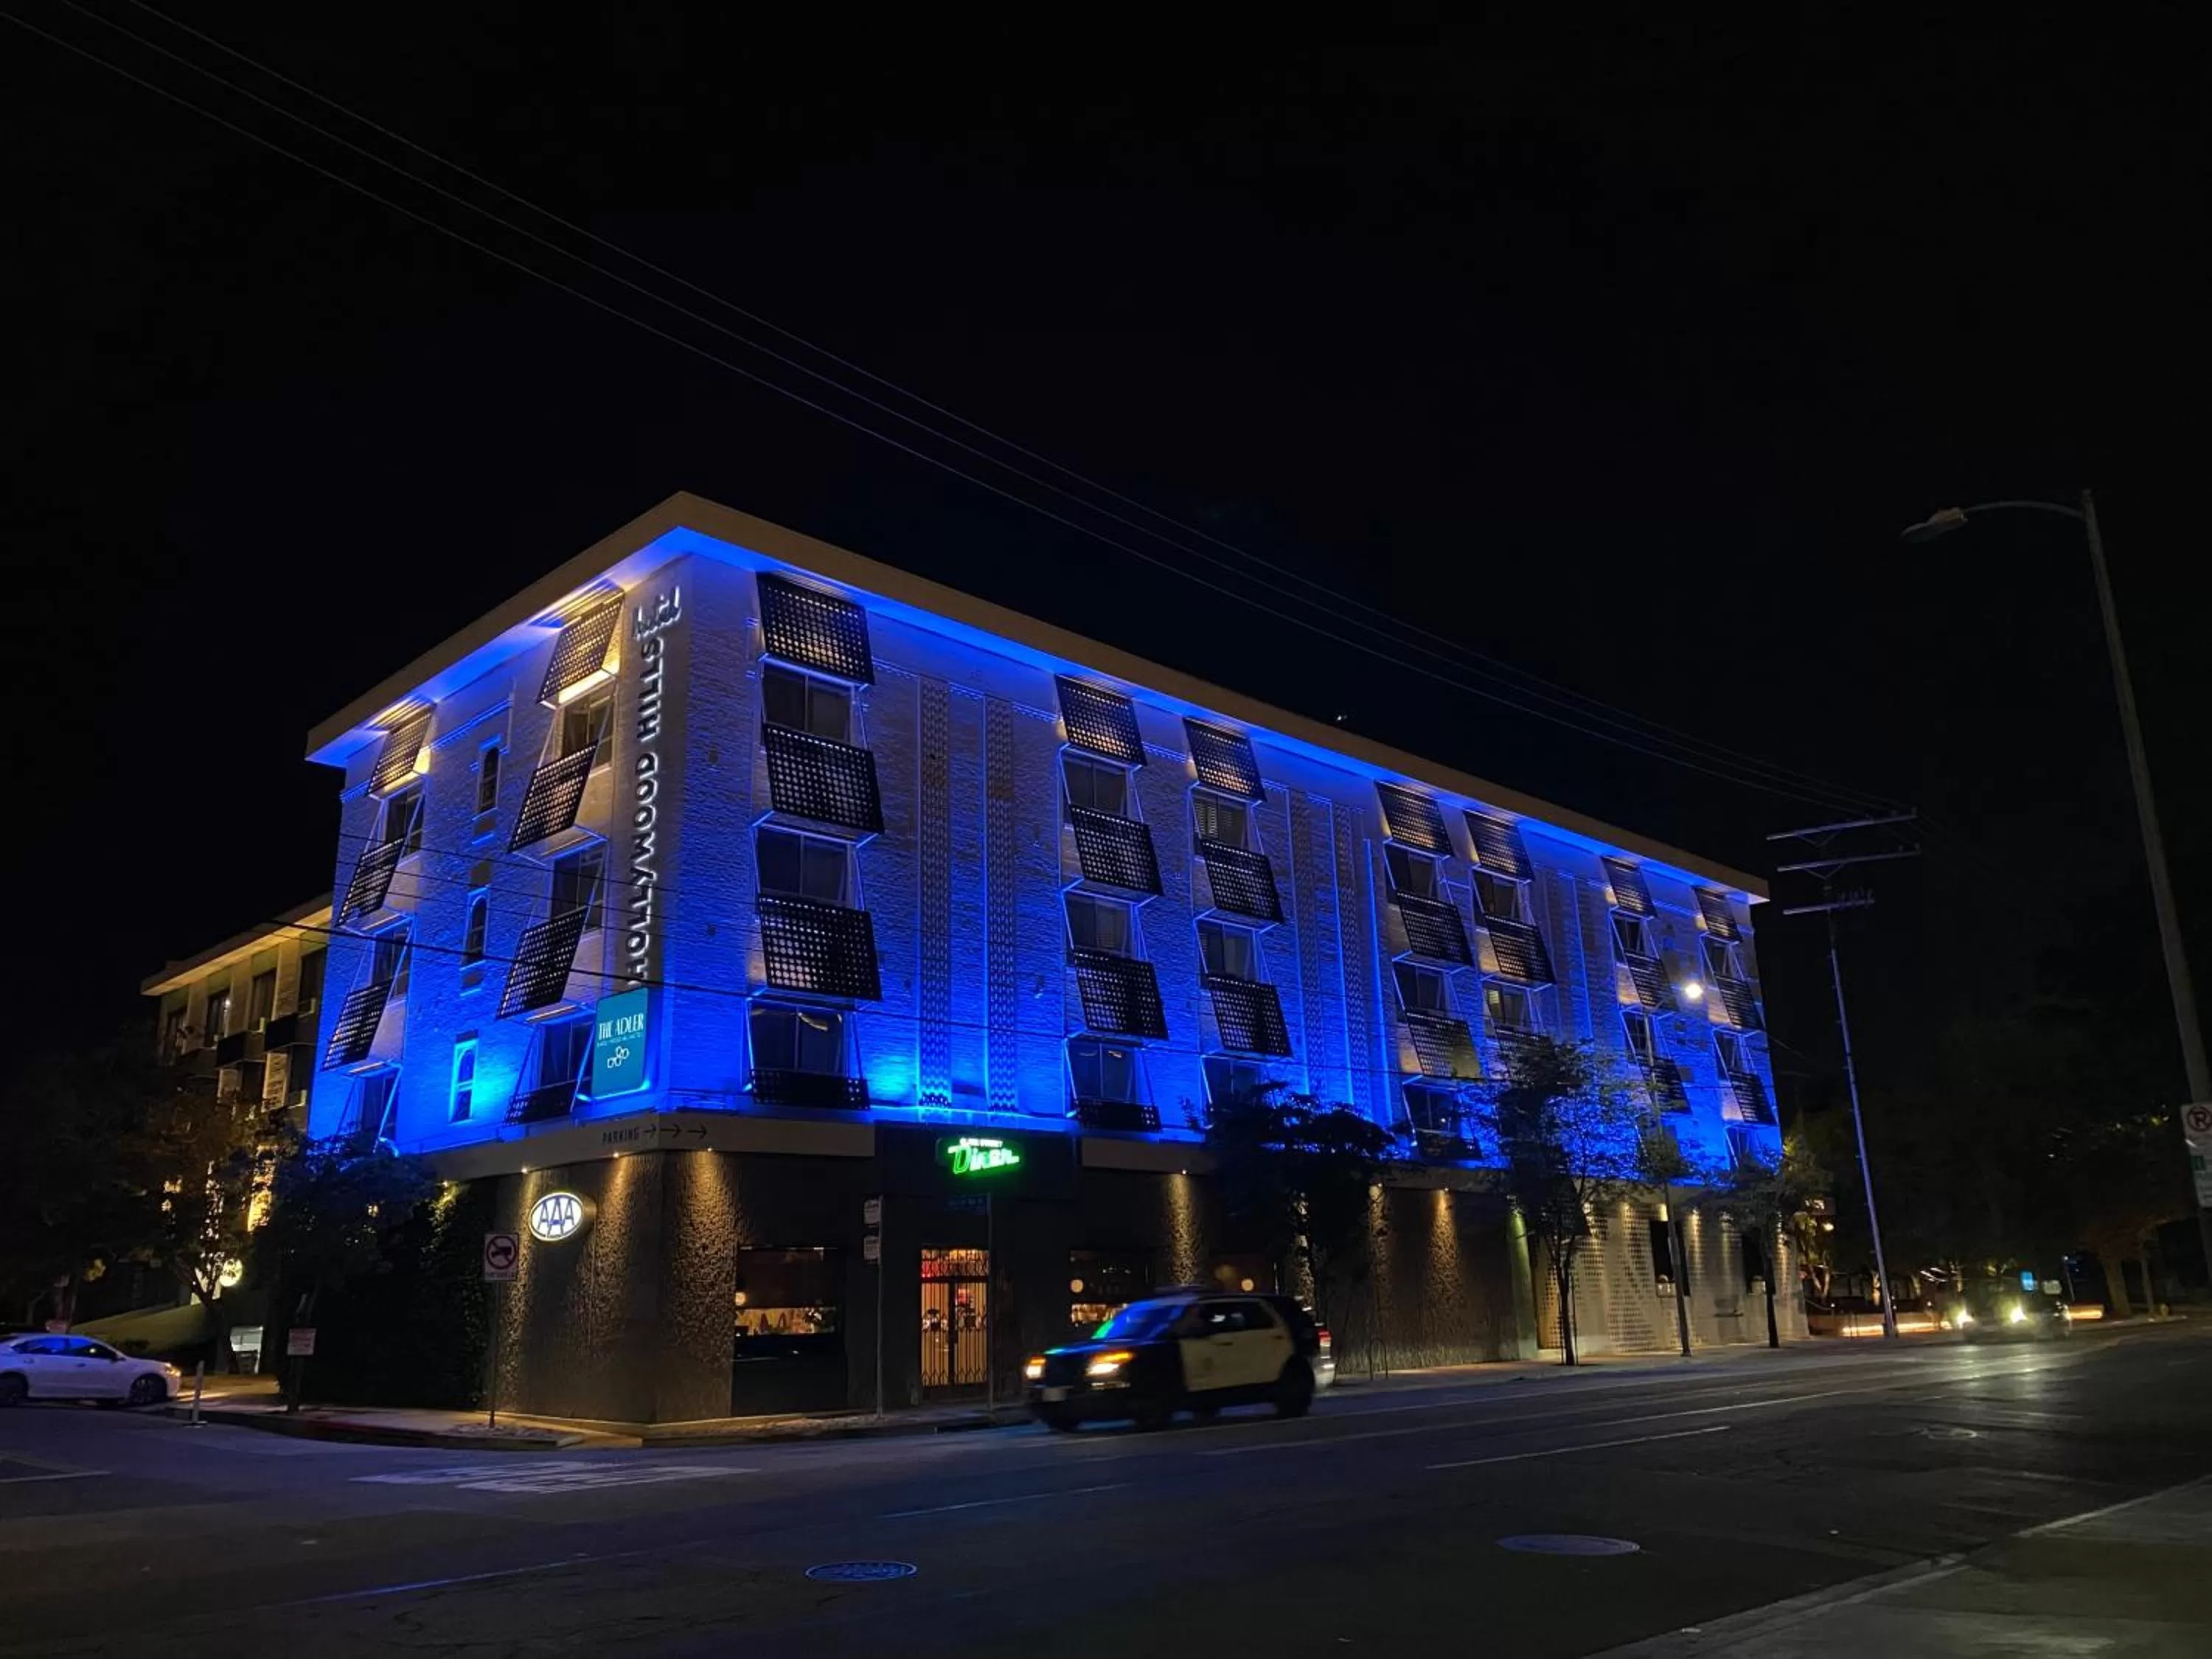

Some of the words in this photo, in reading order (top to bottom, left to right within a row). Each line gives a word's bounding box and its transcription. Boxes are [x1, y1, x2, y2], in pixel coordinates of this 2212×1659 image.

[637, 637, 664, 742] HILLS
[625, 752, 659, 985] HOLLYWOOD
[614, 1012, 644, 1036] ADLER
[601, 1127, 640, 1144] PARKING
[536, 1195, 576, 1237] AAA
